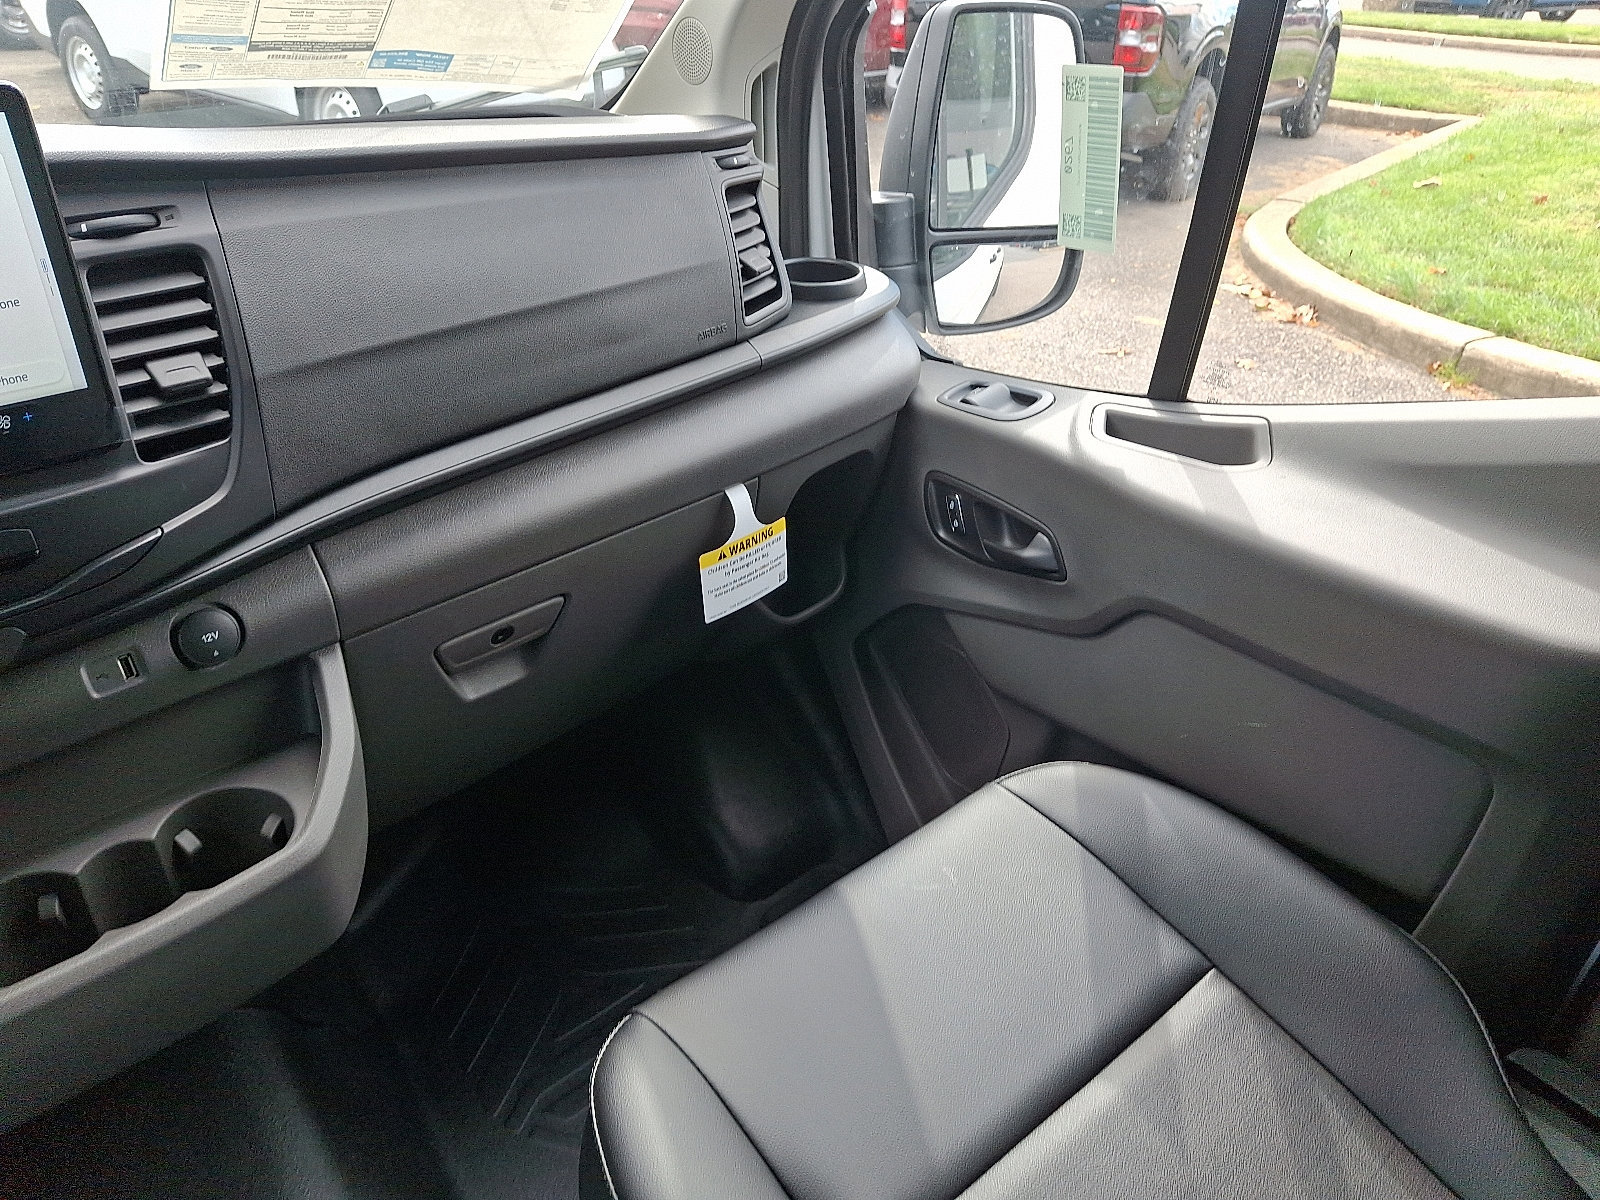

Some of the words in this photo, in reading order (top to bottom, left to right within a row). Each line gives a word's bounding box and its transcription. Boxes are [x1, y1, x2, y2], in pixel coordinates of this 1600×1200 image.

[697, 323, 728, 342] AIRBAG
[0, 374, 29, 386] hone
[728, 526, 774, 557] WARNING
[201, 630, 220, 644] 12V
